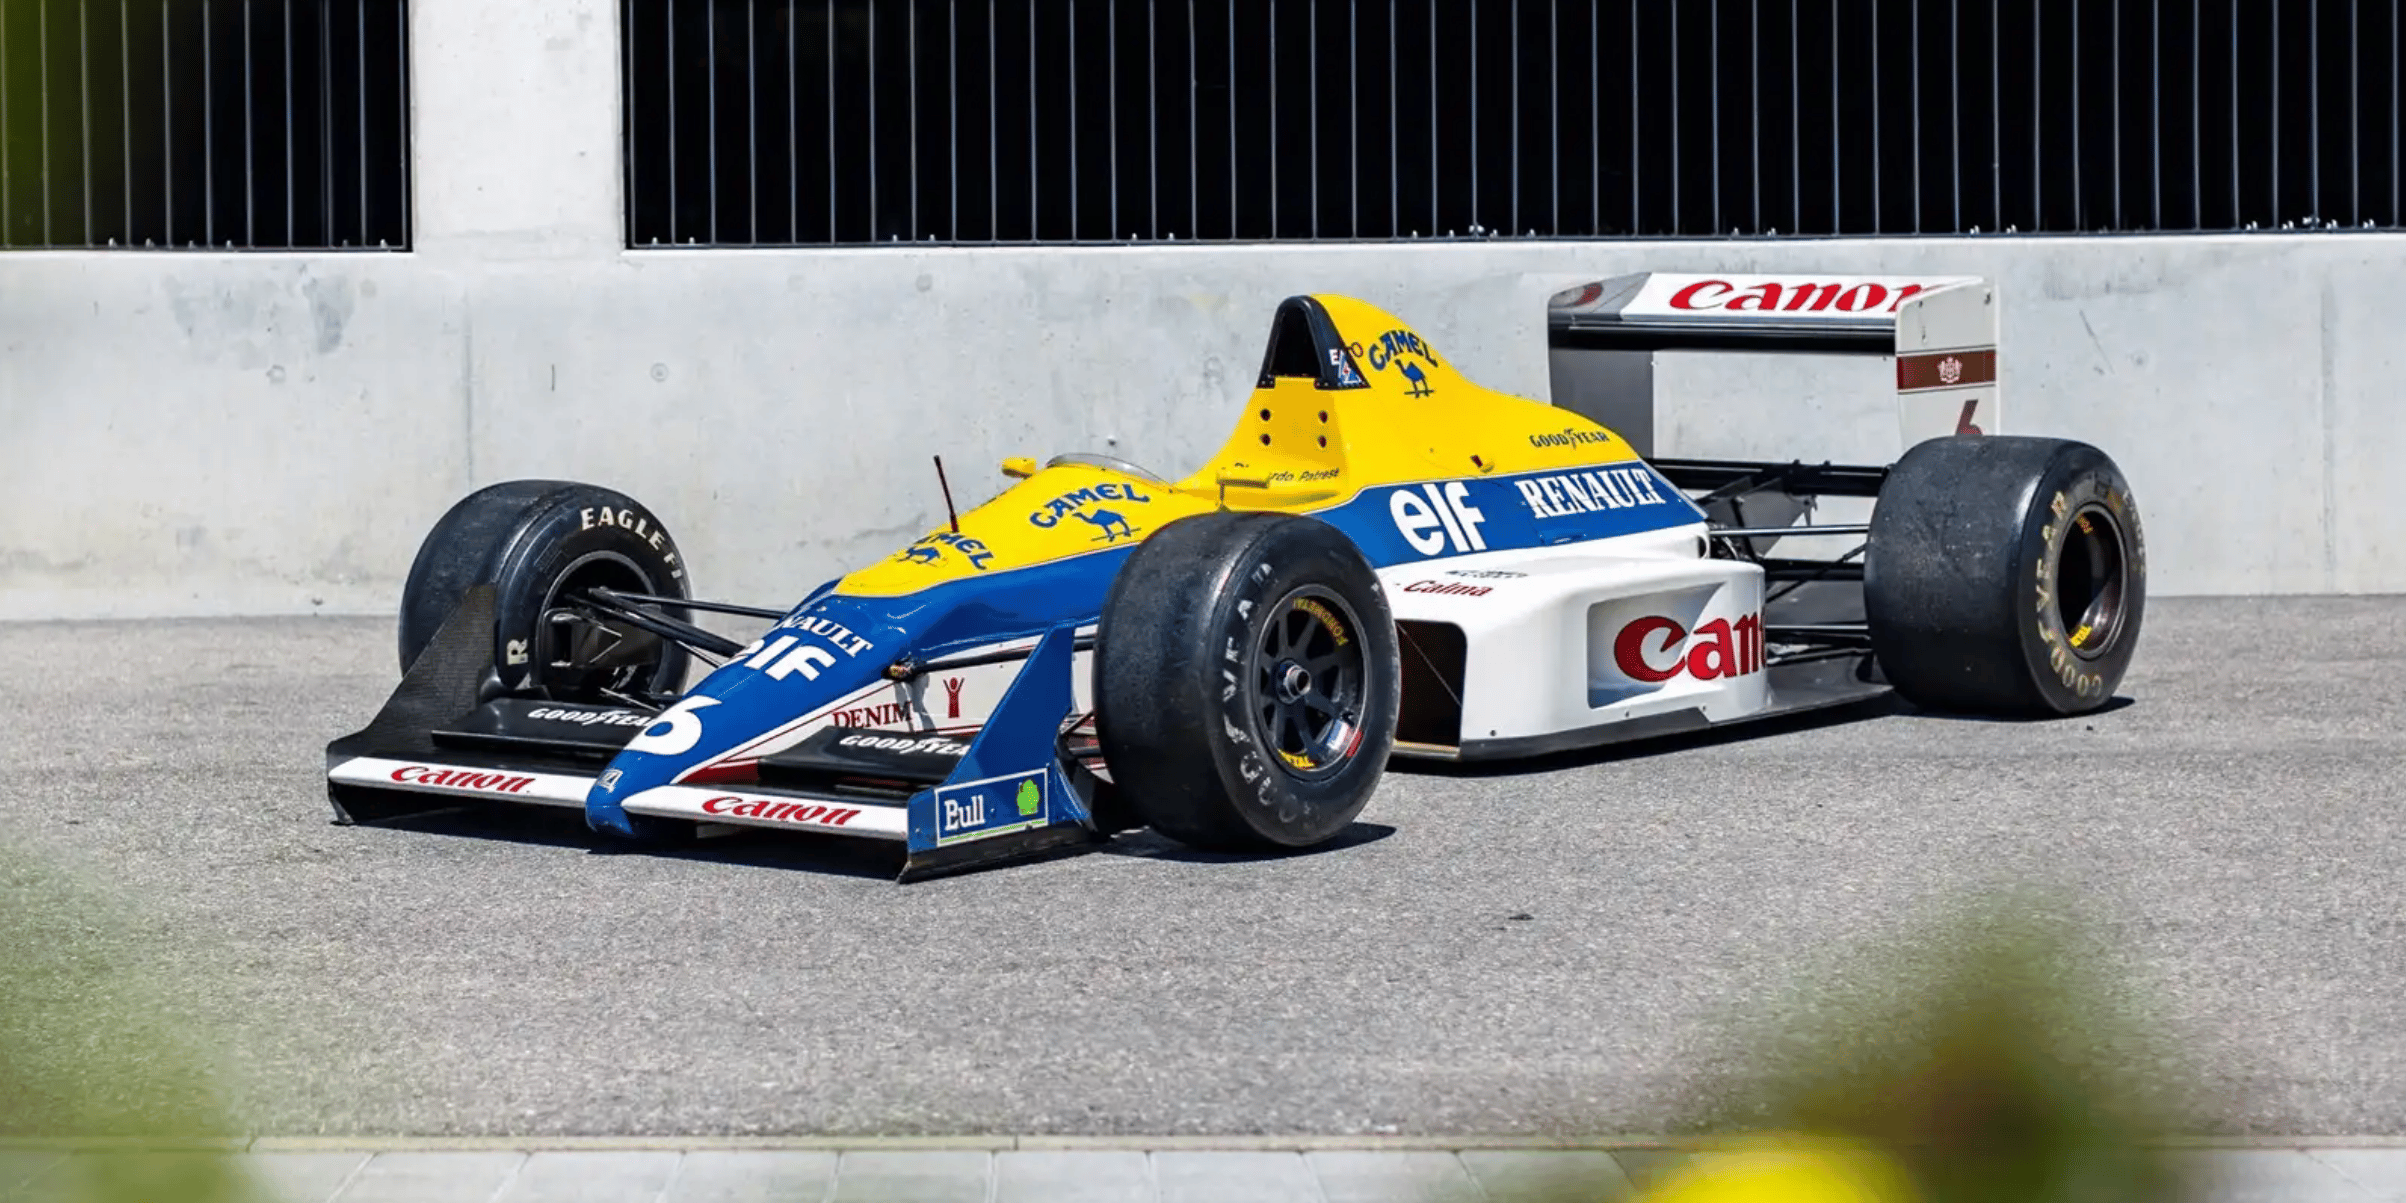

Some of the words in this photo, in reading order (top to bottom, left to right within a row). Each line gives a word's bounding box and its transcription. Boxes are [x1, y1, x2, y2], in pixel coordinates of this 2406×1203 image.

[1369, 330, 1438, 371] CAMEL
[1529, 428, 1610, 450] GOODYEAR
[1029, 483, 1150, 528] CAMEL
[1389, 481, 1487, 556] elf
[1514, 468, 1667, 519] RENAULT
[581, 505, 665, 550] EAGLE
[1613, 612, 1766, 683] Can
[528, 708, 653, 727] GOODYEA
[624, 694, 722, 755] 6
[832, 702, 913, 729] DENIM
[839, 734, 970, 756] GOODYEA
[391, 756, 536, 793] Canon
[702, 796, 862, 826] Canon
[944, 794, 986, 831] Bull
